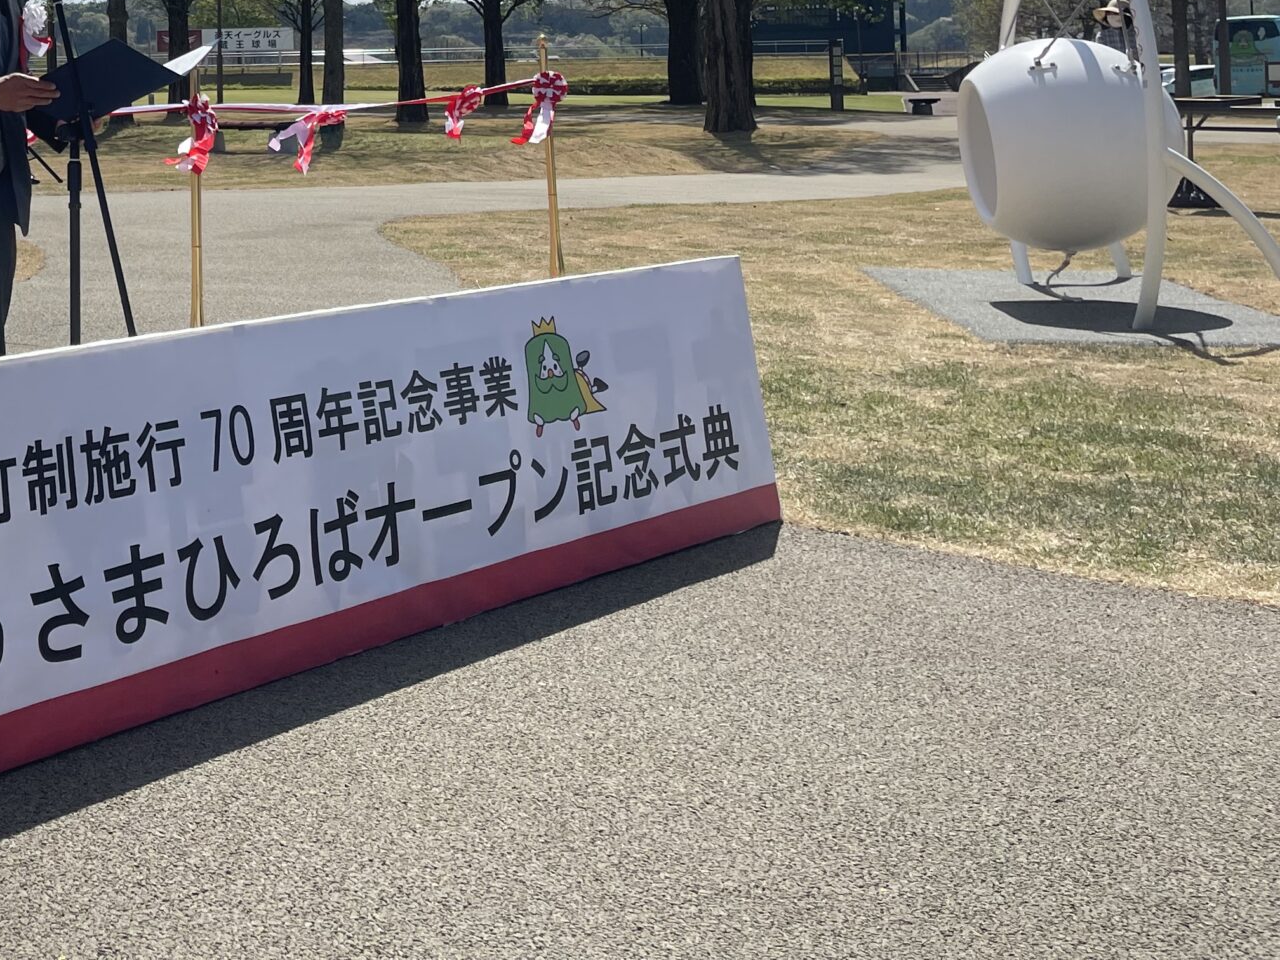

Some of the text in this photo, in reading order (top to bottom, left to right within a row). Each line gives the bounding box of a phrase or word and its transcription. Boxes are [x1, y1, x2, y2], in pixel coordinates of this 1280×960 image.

[200, 404, 255, 473] 70
[269, 356, 519, 464] 周年記念事業
